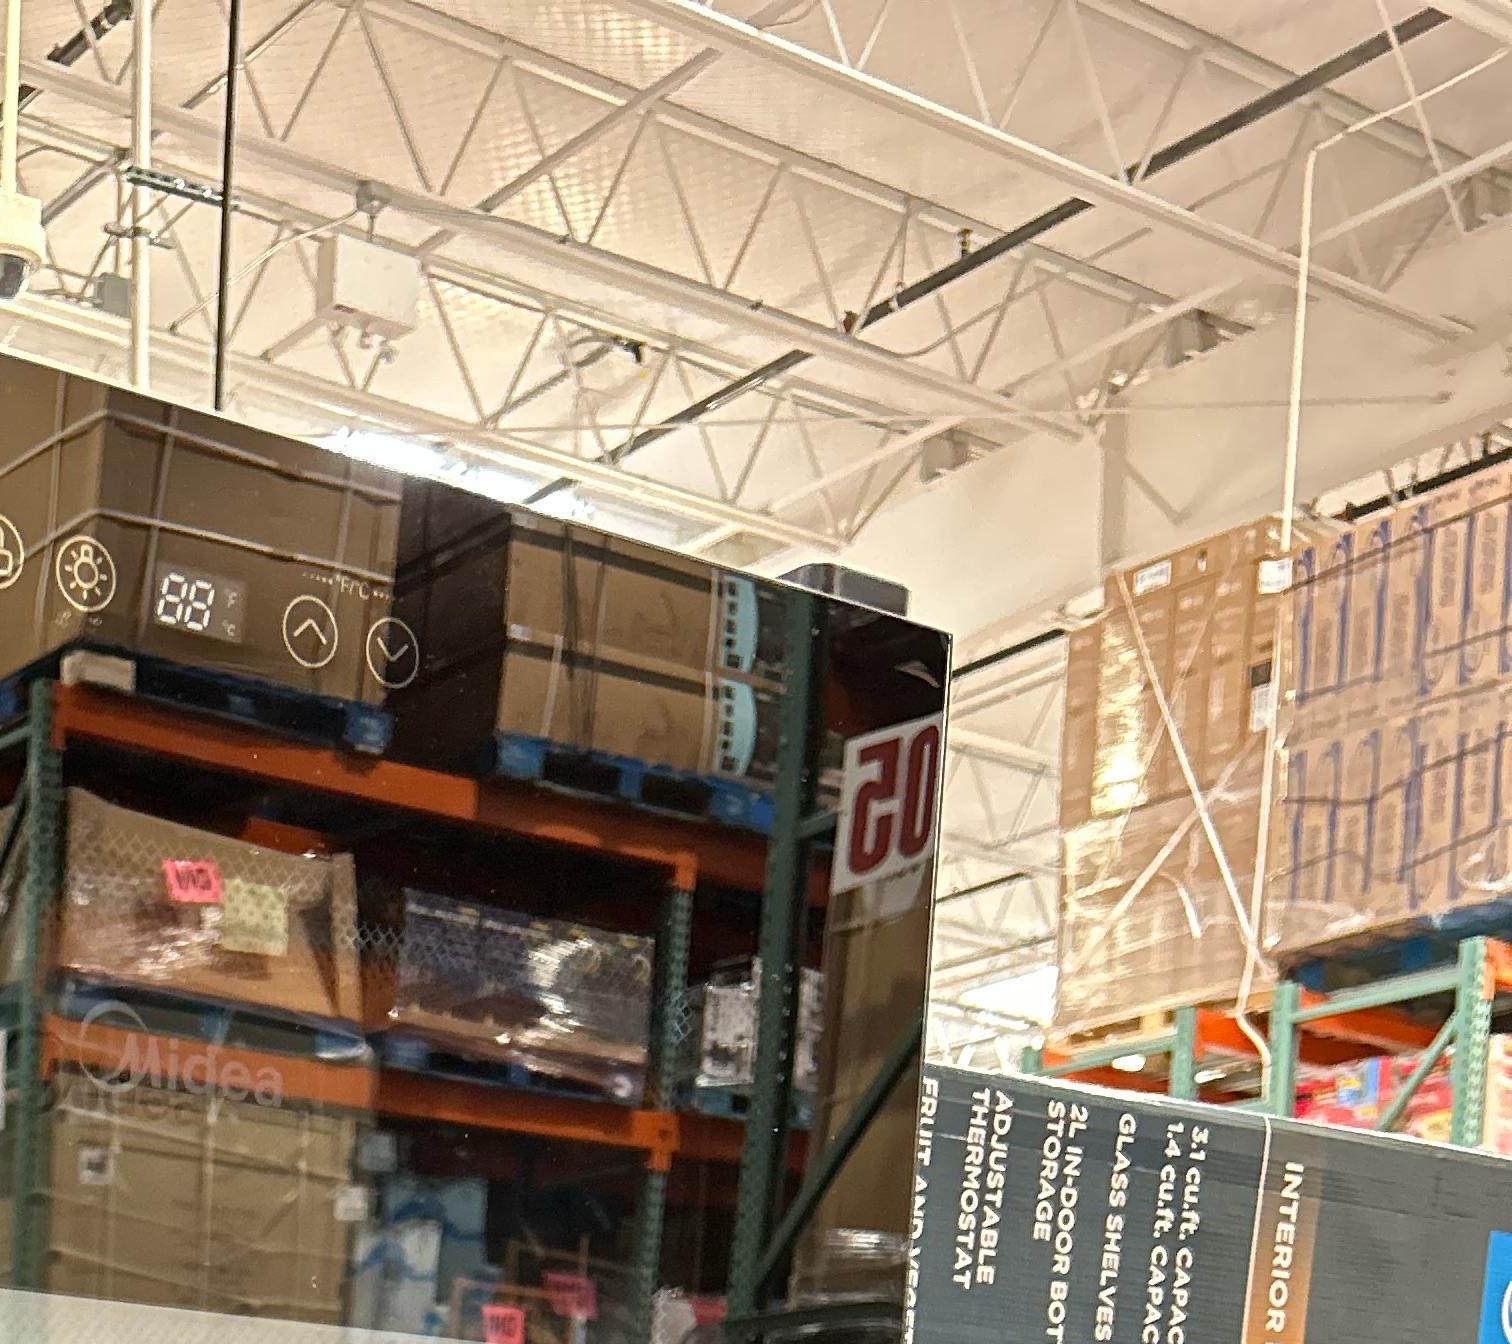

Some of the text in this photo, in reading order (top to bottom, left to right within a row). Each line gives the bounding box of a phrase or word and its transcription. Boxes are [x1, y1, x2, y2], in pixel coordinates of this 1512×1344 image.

[93, 1018, 284, 1108] Midea
[918, 1075, 939, 1167] FRUIT
[1067, 1103, 1089, 1139] 2L
[953, 1087, 991, 1290] THERMOSTAT
[975, 1090, 1015, 1286] ADJUSTABLE
[1032, 1100, 1067, 1242] STORAGE
[1163, 1121, 1185, 1159] 1.4
[1189, 1124, 1209, 1162] 3.1
[1051, 1145, 1084, 1275] IN-DOOR
[1094, 1112, 1137, 1342] GLASS SHELVES
[1264, 1160, 1306, 1334] INTERIOR
